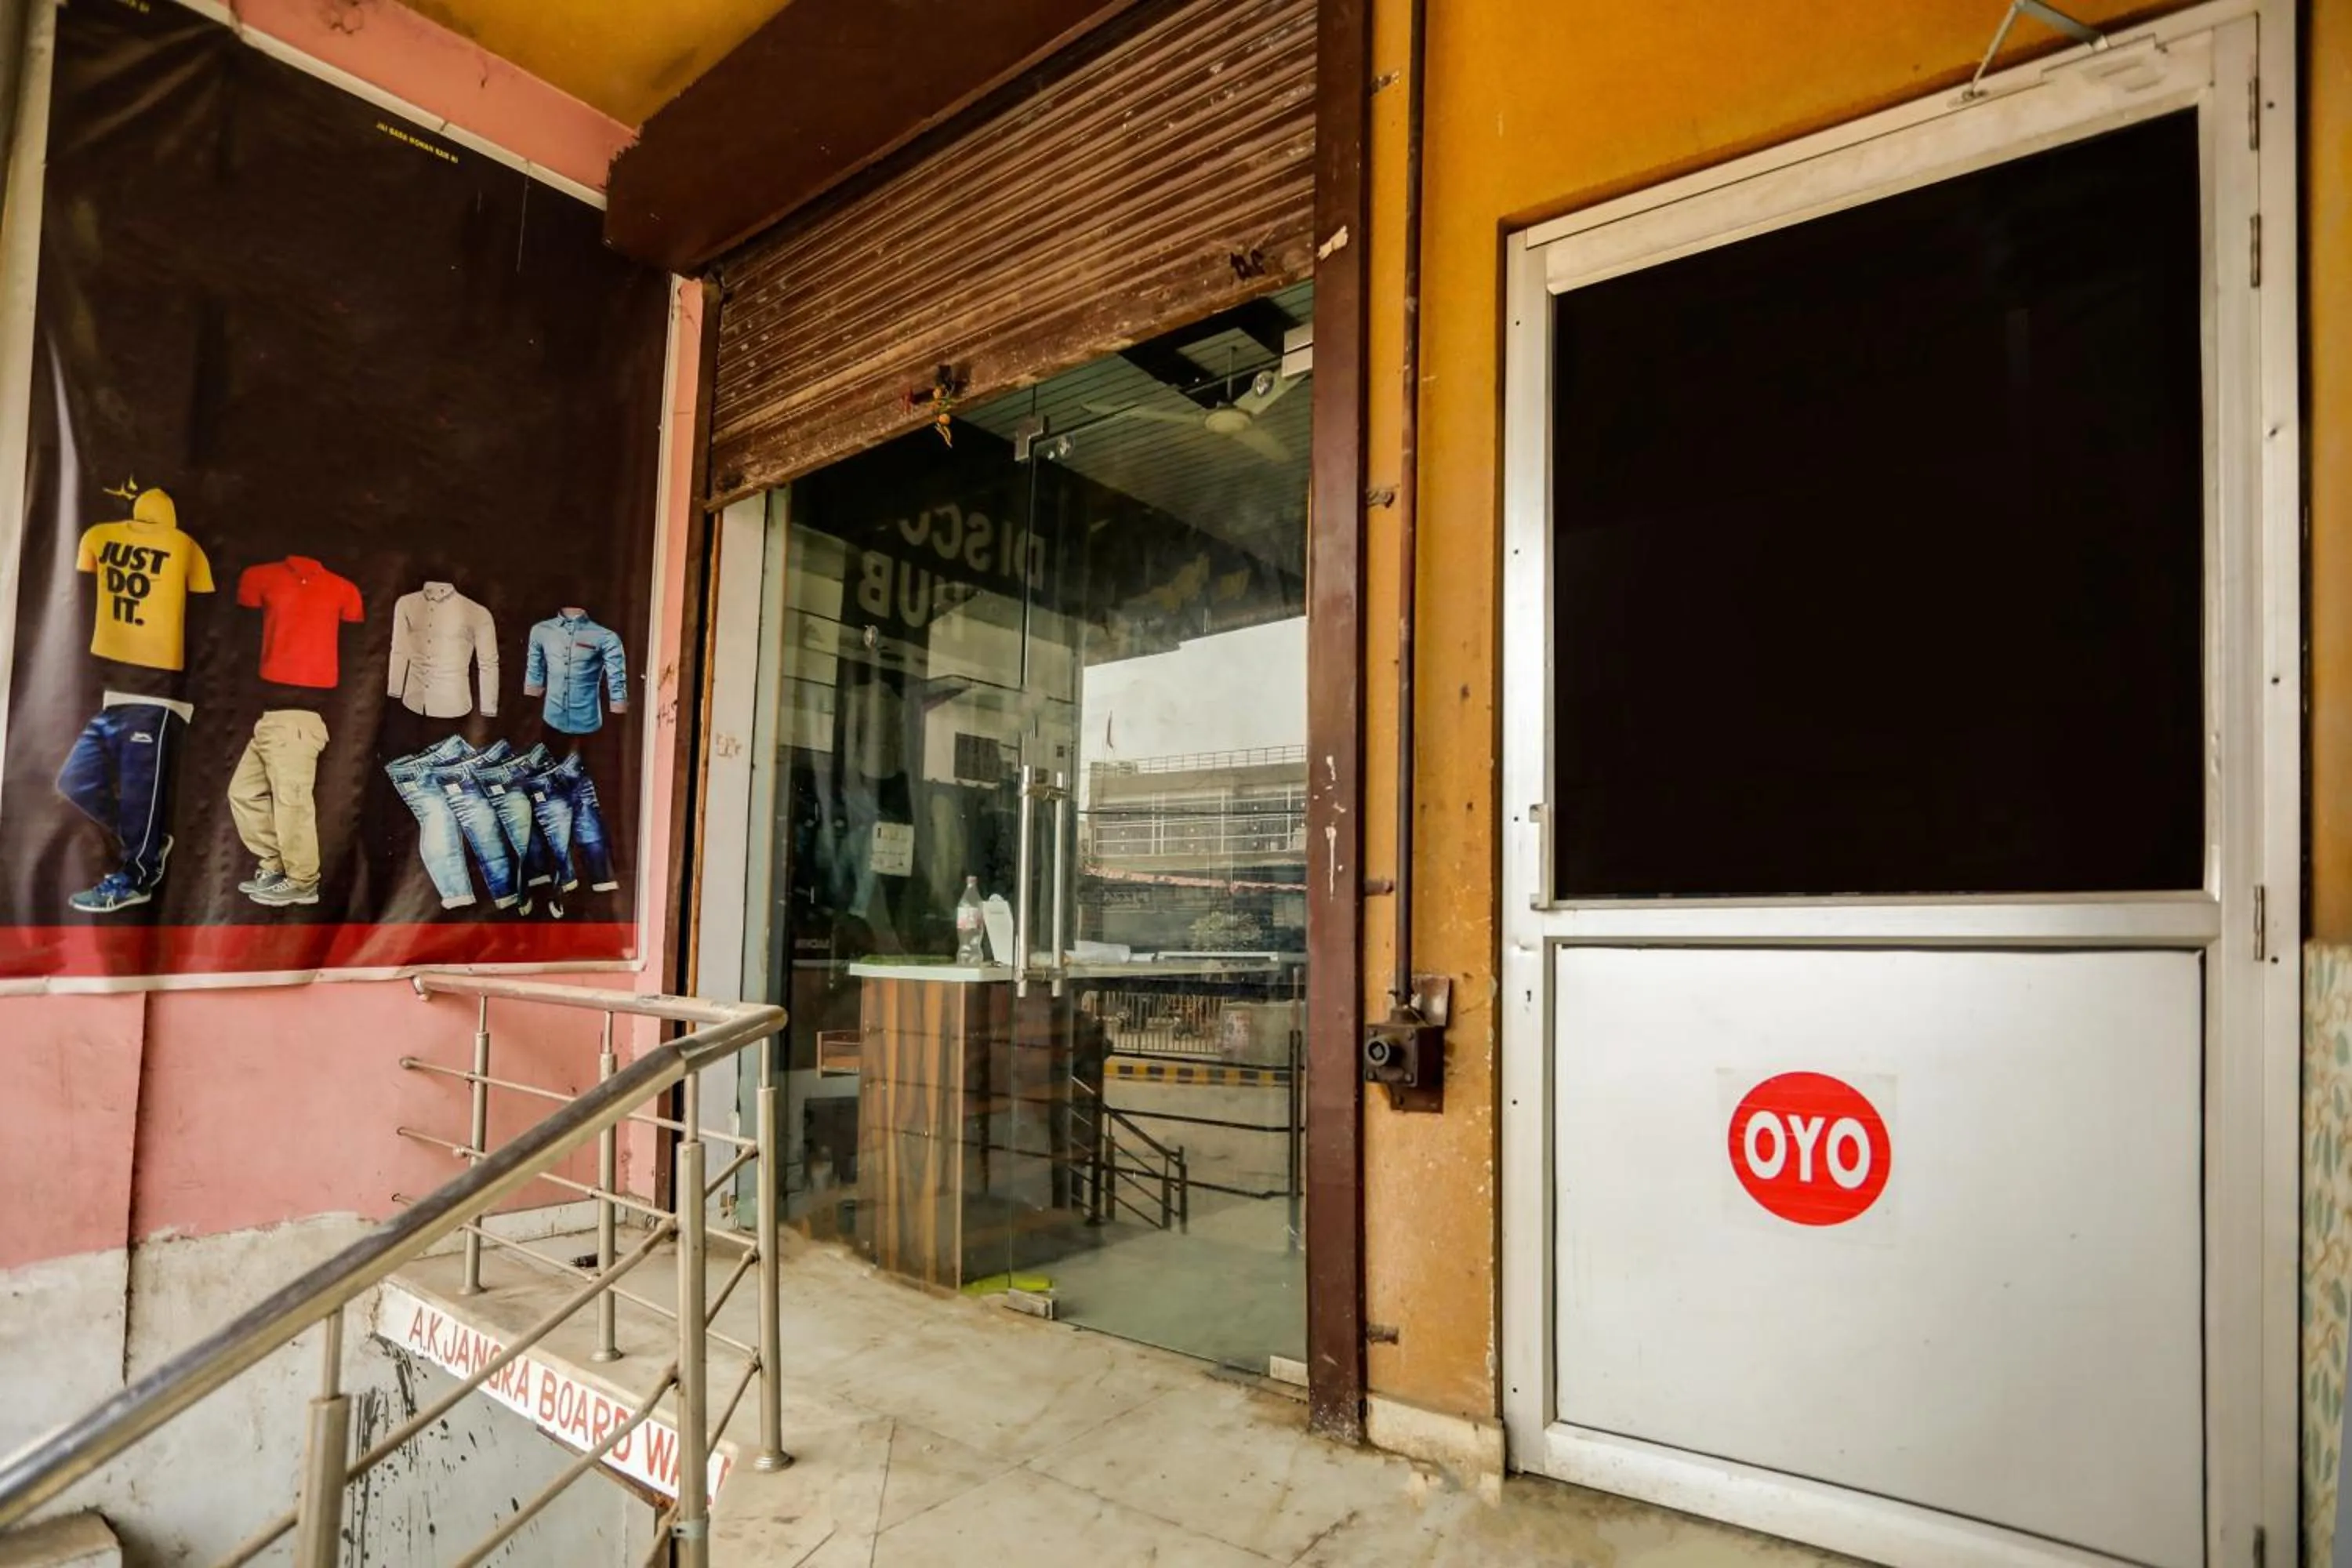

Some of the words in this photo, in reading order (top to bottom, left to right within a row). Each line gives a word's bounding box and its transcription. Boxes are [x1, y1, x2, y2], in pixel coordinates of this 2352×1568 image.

[99, 541, 170, 575] JUST
[107, 566, 151, 599] DO
[113, 595, 144, 626] IT.
[1744, 1109, 1871, 1189] OYO
[539, 1369, 632, 1461] BOARD
